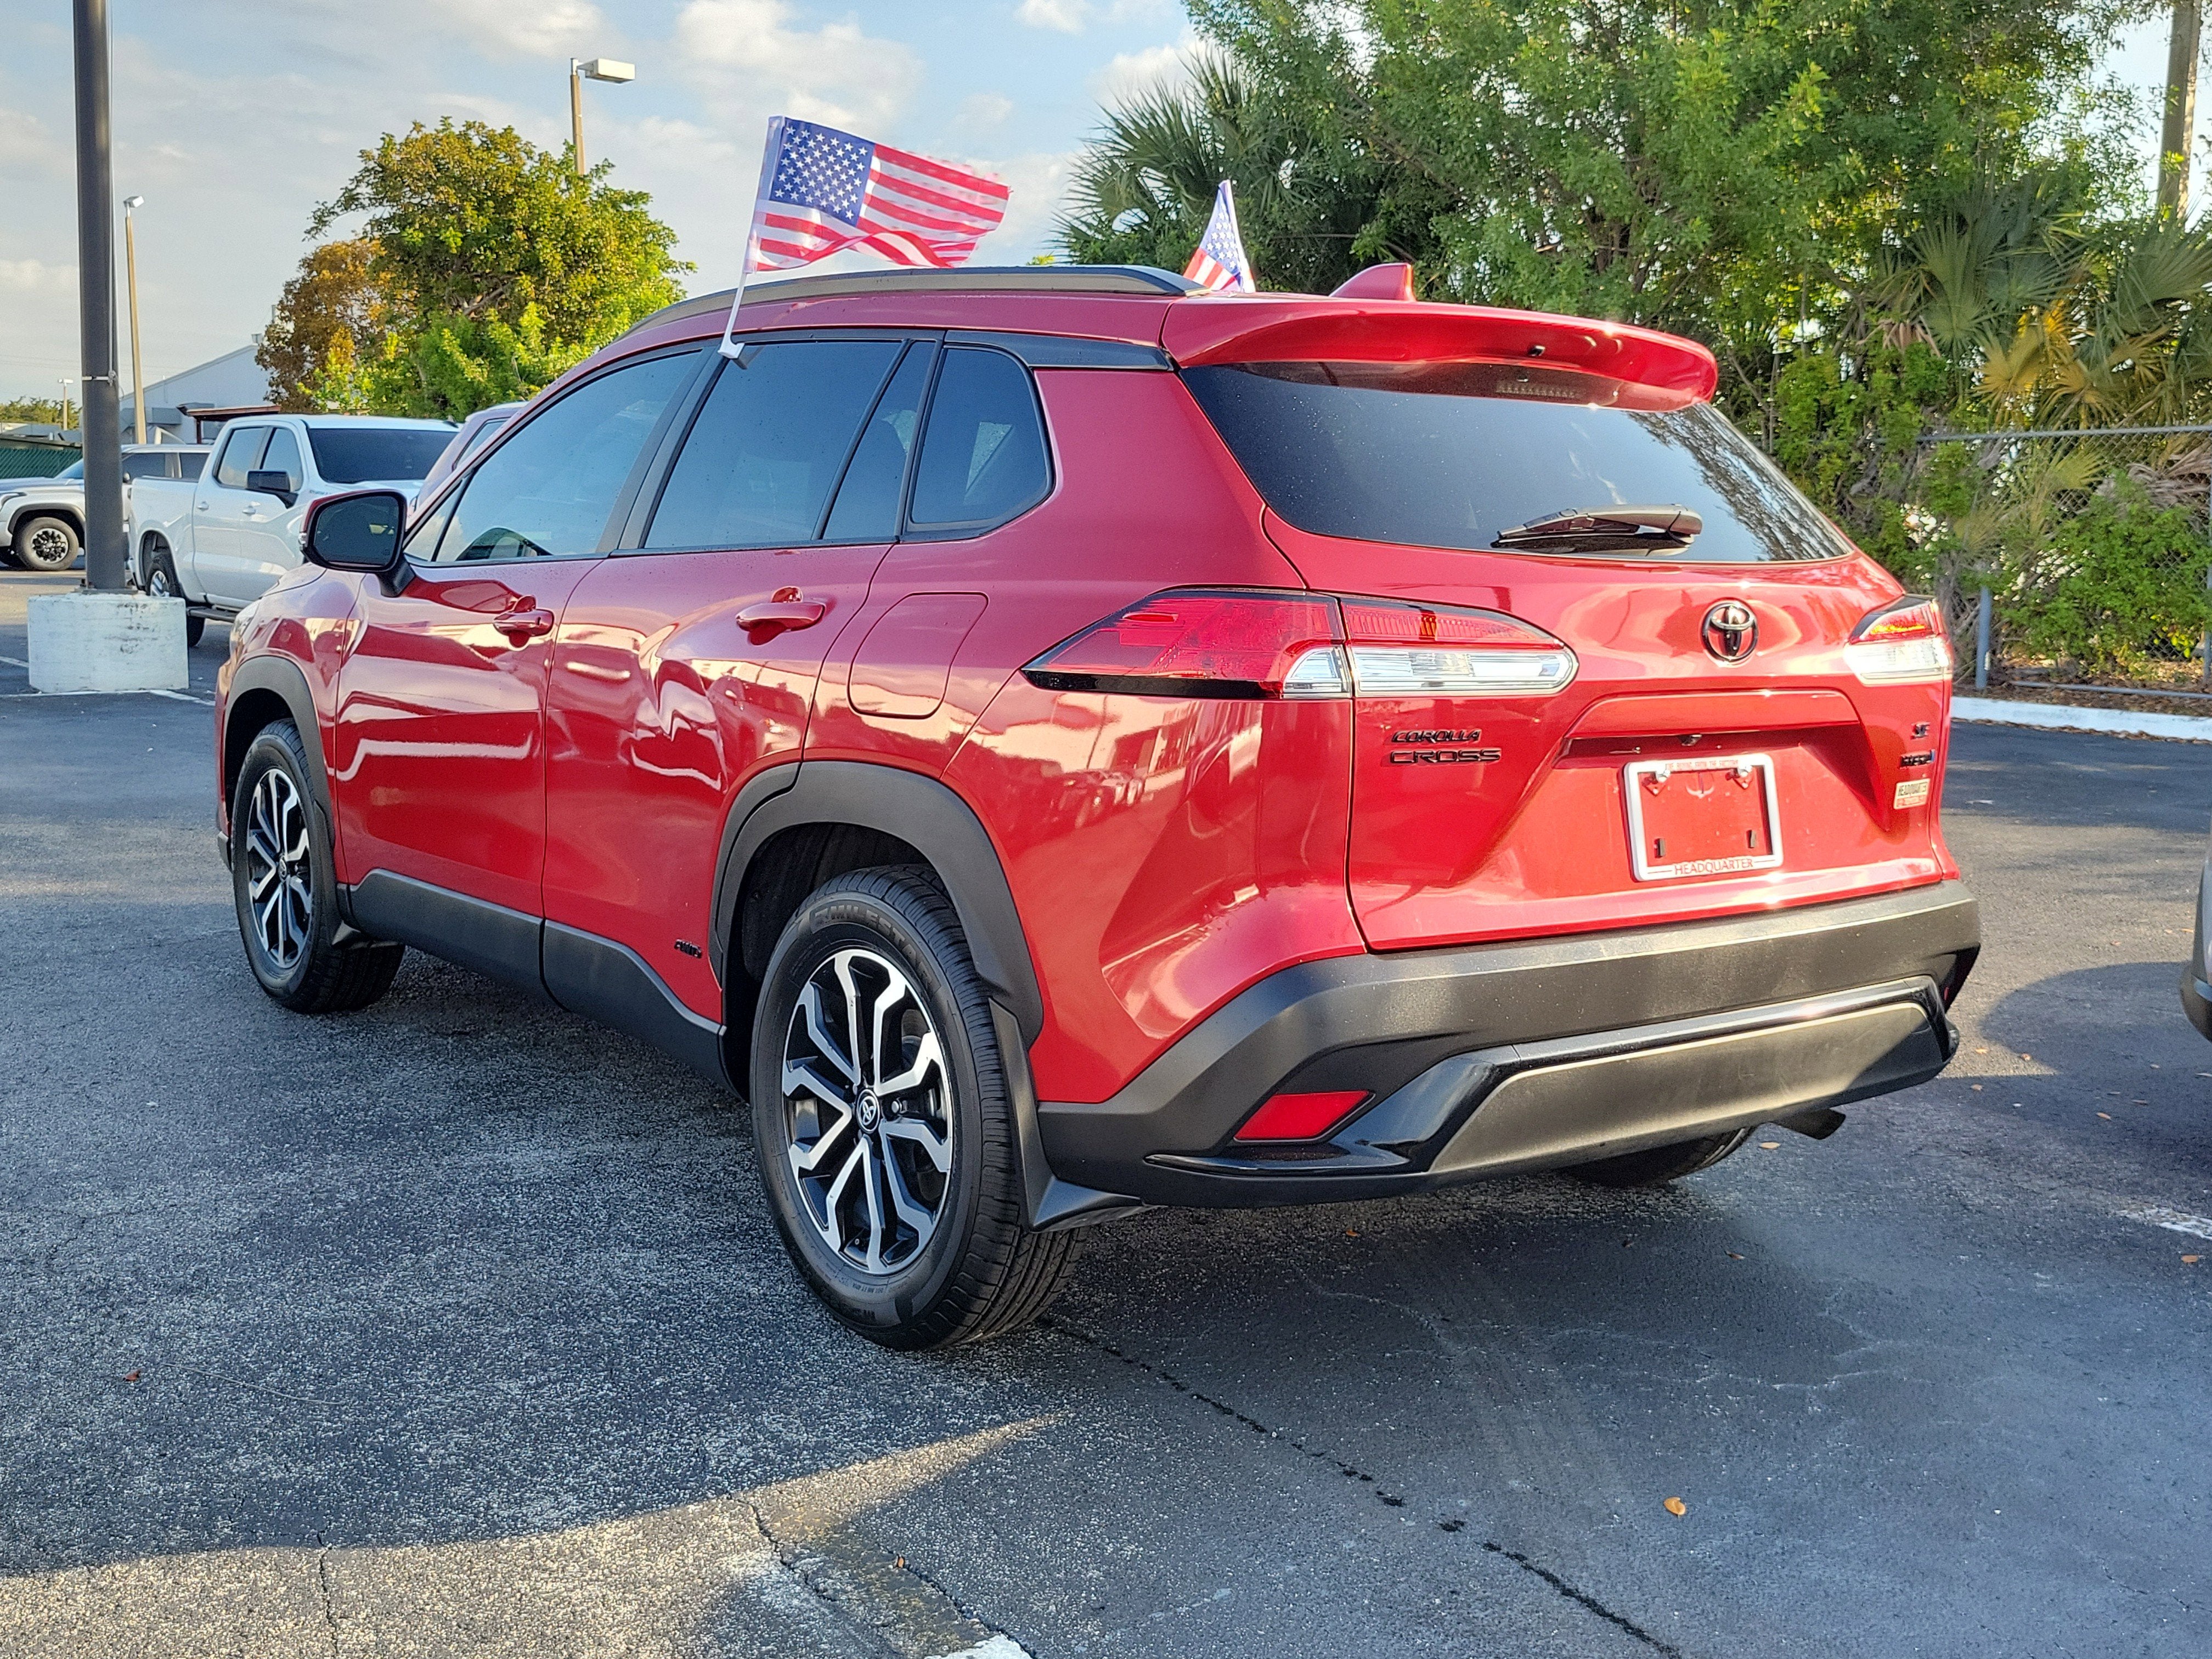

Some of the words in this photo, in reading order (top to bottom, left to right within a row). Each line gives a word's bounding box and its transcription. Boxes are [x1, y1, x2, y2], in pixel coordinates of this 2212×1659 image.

[1392, 729, 1481, 743] COROLLA
[1390, 748, 1502, 764] CROSS
[1674, 858, 1754, 875] HEADQUARTER
